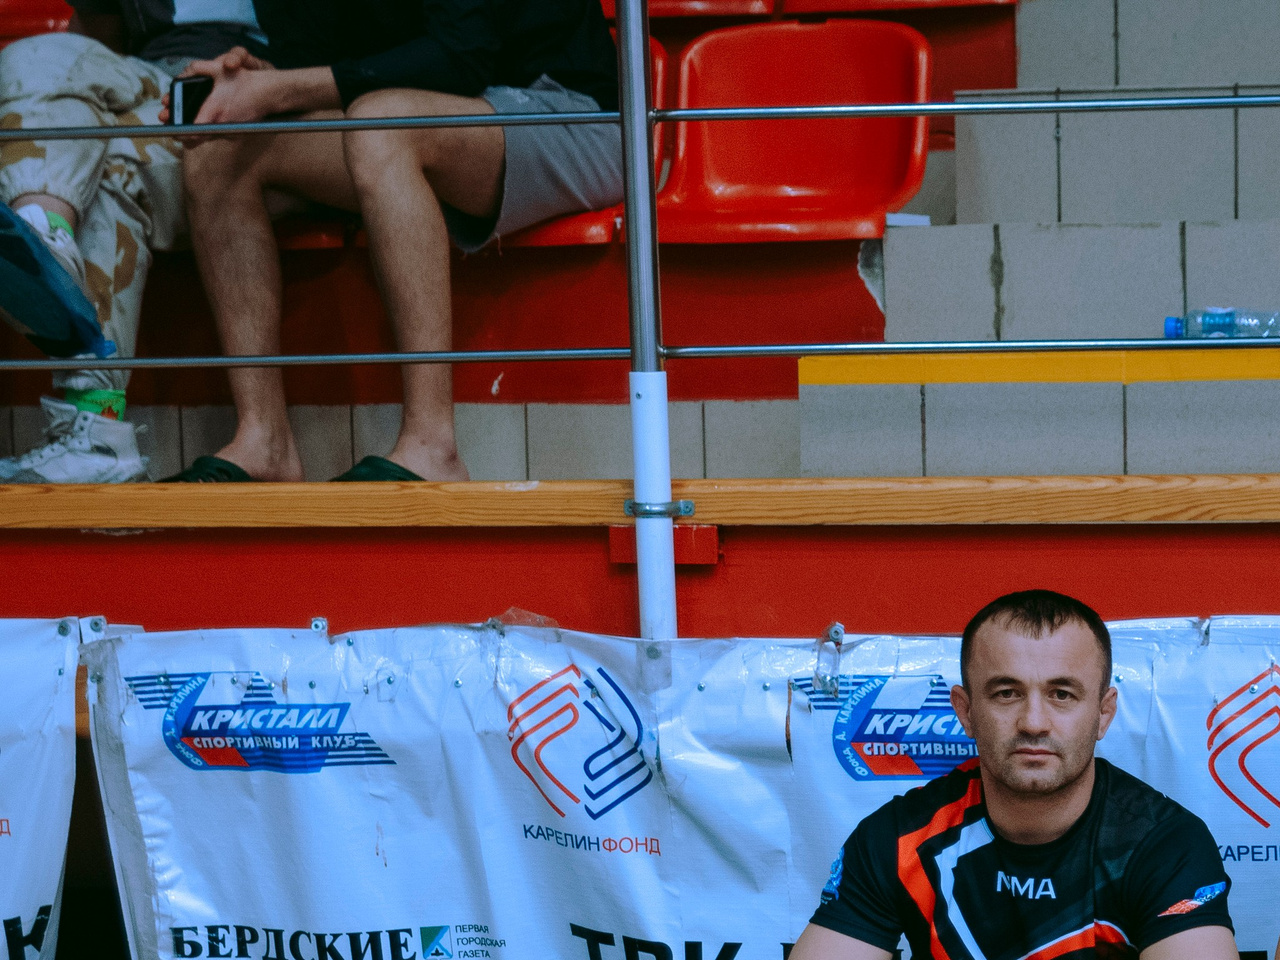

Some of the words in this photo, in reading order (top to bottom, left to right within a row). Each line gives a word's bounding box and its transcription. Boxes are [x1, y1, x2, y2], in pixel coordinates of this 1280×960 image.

[836, 677, 885, 725] КАРЕЛИНА
[190, 707, 341, 731] КРИСТАЛЛ
[863, 713, 968, 736] КРИСТ
[192, 735, 300, 750] СПОРТИВНЫЙ
[311, 736, 356, 750] КЛУБ
[455, 924, 490, 934] ПЕРВАЯ
[456, 937, 507, 948] ГОРОДСКАЯ
[458, 949, 491, 959] ГАЗЕТА
